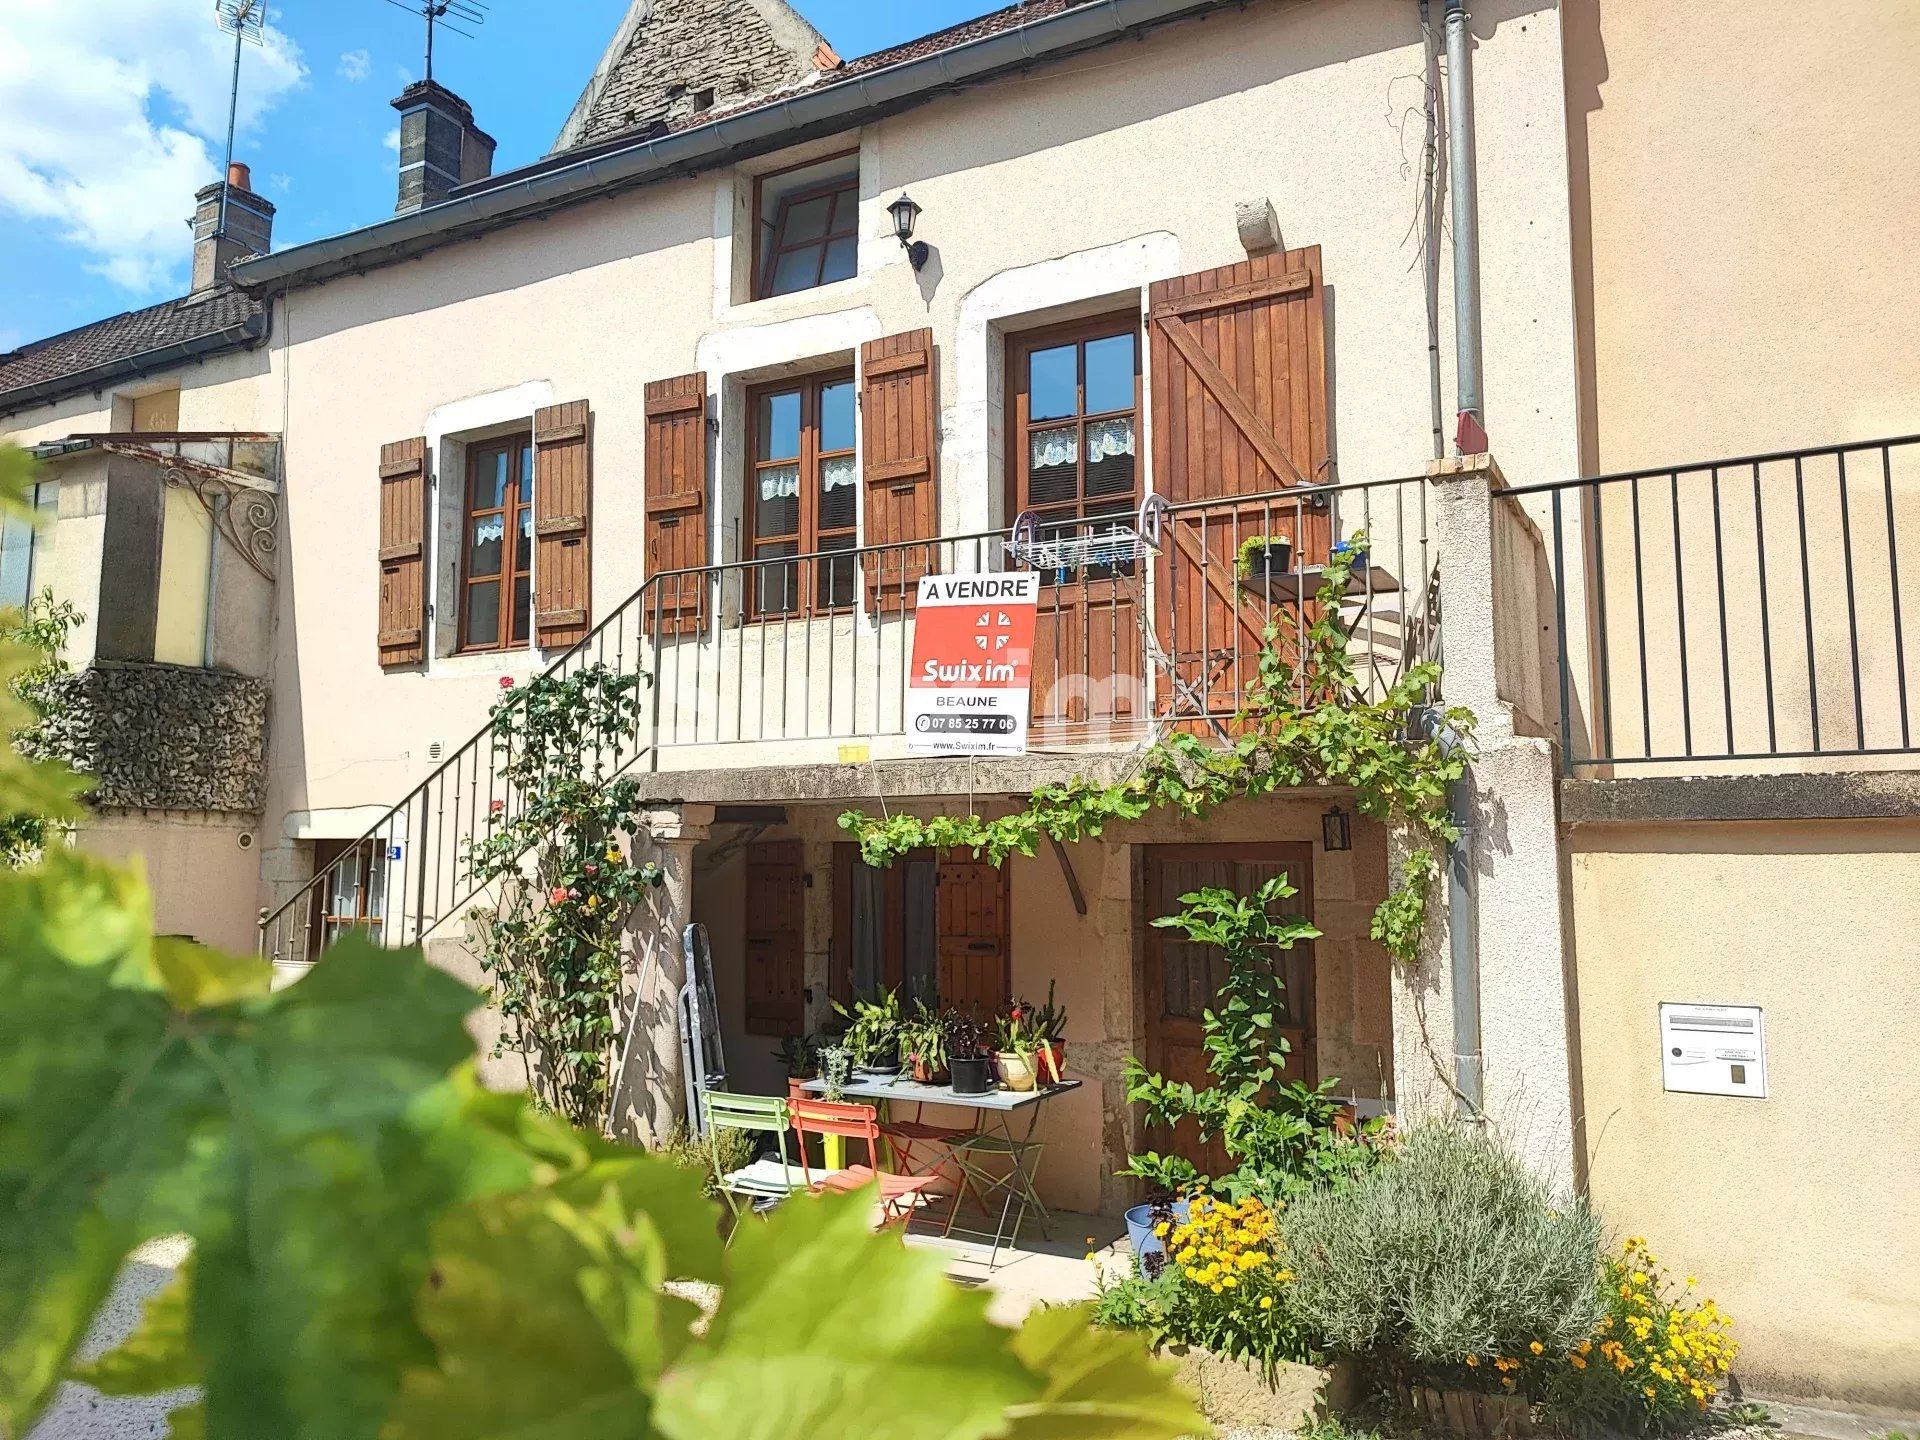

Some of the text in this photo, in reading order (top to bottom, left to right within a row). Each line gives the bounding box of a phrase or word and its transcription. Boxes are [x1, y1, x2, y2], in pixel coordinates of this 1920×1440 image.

[926, 580, 1029, 599] A VENDRE
[922, 659, 1015, 682] Swixim
[936, 696, 998, 707] BEAUNE
[932, 719, 945, 729] 07
[948, 719, 962, 729] 85
[965, 719, 979, 730] 25
[982, 719, 996, 730] 77
